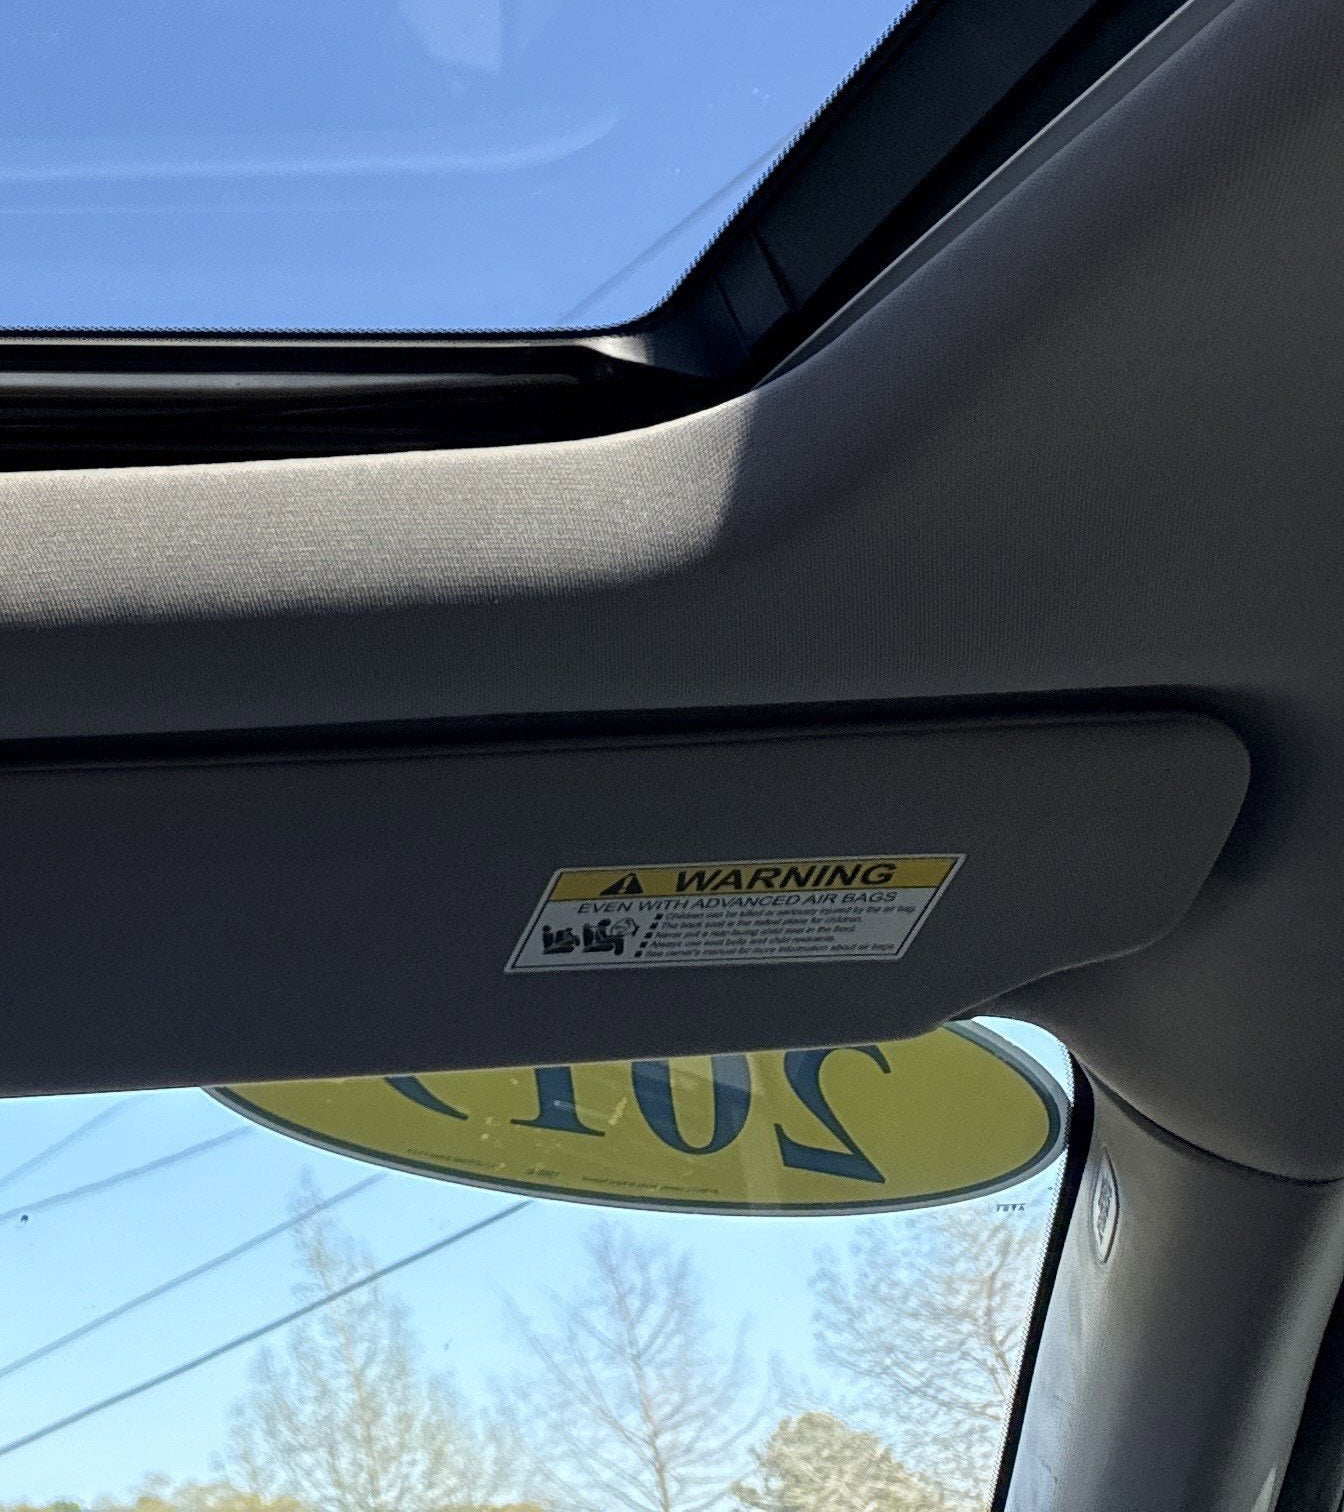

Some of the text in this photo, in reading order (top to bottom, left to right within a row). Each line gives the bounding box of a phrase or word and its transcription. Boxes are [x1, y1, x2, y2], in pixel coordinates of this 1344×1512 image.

[675, 863, 897, 892] WARNING
[577, 891, 898, 914] EVEN WITH ADVANCED AIR BAGS
